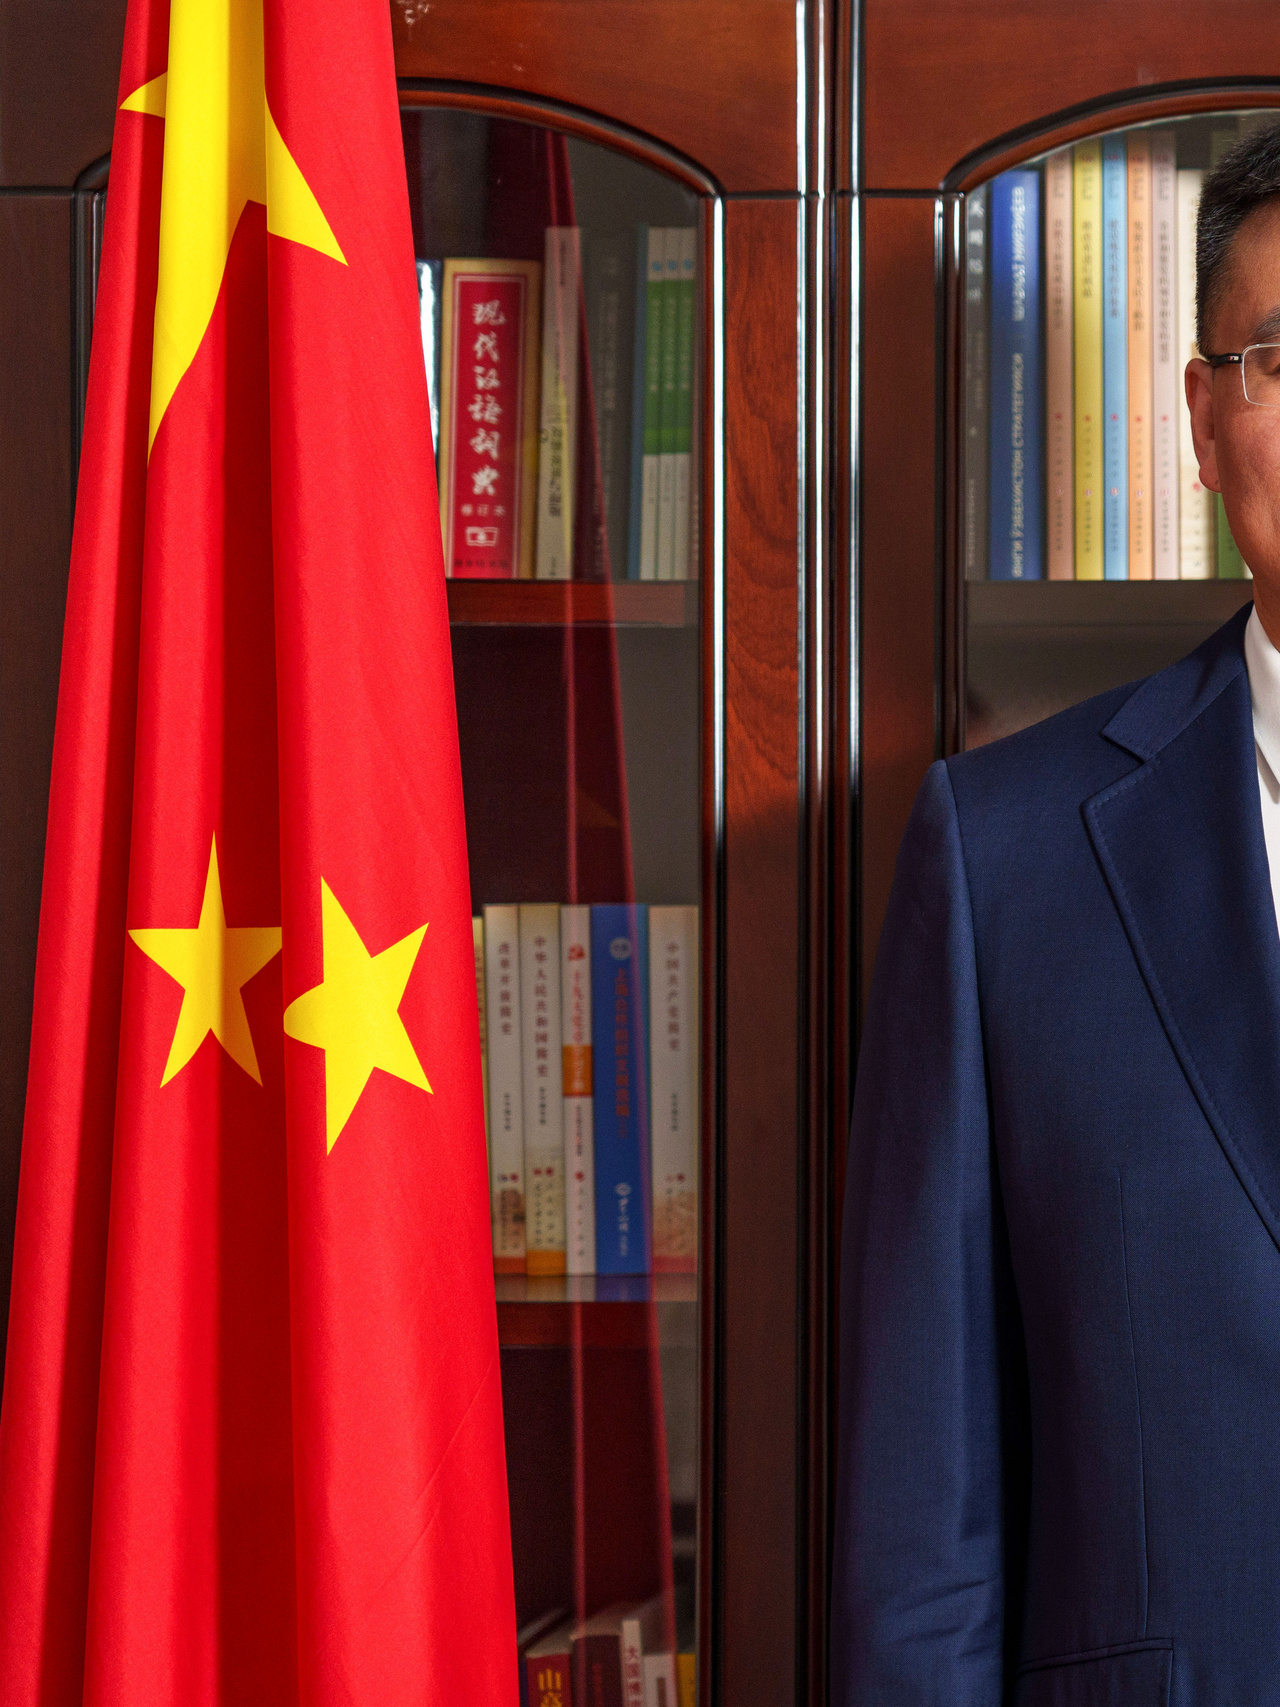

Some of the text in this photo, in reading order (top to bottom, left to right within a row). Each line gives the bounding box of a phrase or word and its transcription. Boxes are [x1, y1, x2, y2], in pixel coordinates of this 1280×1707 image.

[467, 300, 506, 495] 现代汉语词典
